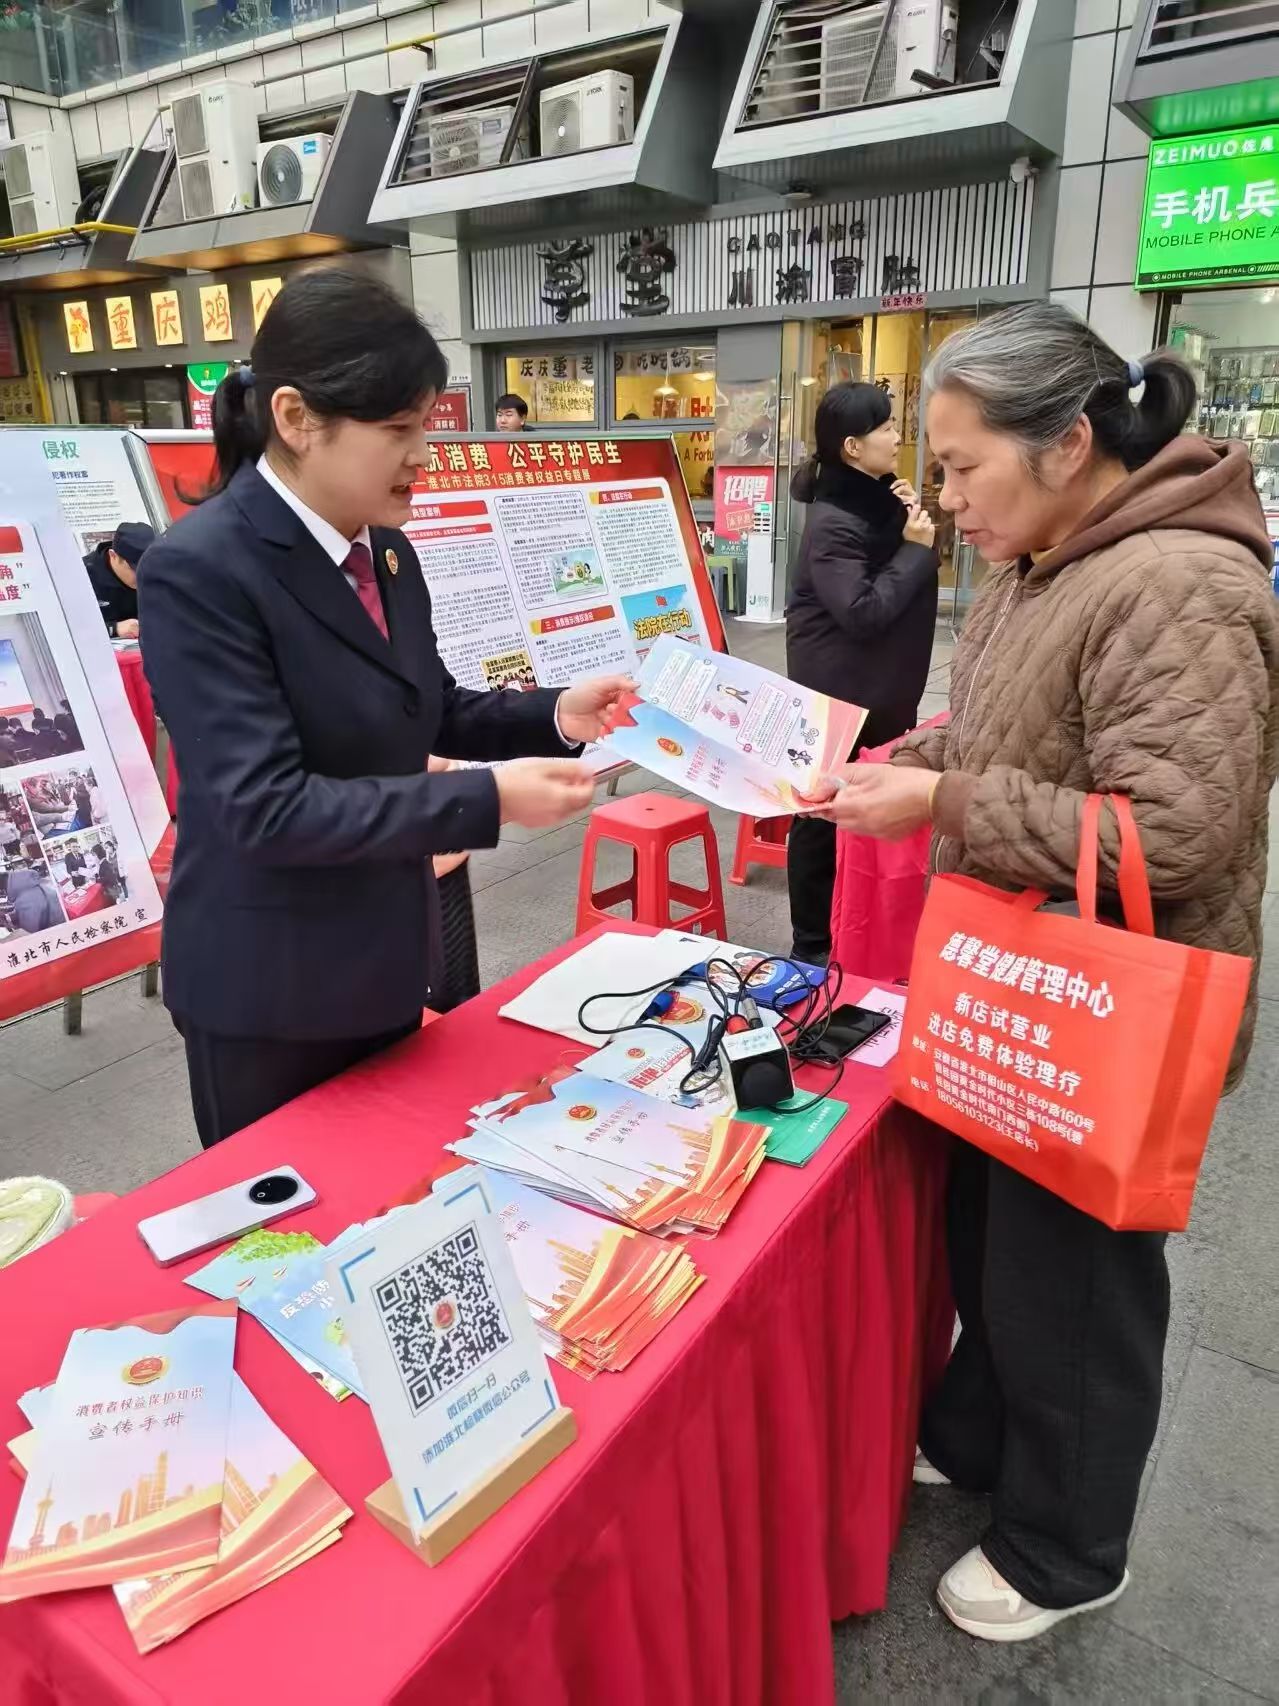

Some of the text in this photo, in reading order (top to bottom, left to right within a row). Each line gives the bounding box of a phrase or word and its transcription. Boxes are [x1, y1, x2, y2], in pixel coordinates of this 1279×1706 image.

[1154, 139, 1238, 165] ZEIMUO
[1151, 179, 1279, 229] 手机兵
[1146, 232, 1204, 249] MOBILE
[1209, 226, 1266, 243] PHONE
[1161, 266, 1247, 281] MOBILE PHONE ARSENAL
[43, 440, 80, 459] 侵权
[507, 441, 622, 468] 公平守护民生
[724, 475, 768, 506] 招聘
[633, 608, 692, 640] 法院在行动
[7, 908, 149, 968] 淮北市人民检察院 宣
[954, 992, 1053, 1049] 新店试营业
[927, 1012, 1082, 1097] 进店免费体验理疗
[76, 1386, 204, 1417] 消费者权益保护知识
[446, 1372, 498, 1420] 微信扫一扫
[88, 1411, 185, 1440] 宣传手册
